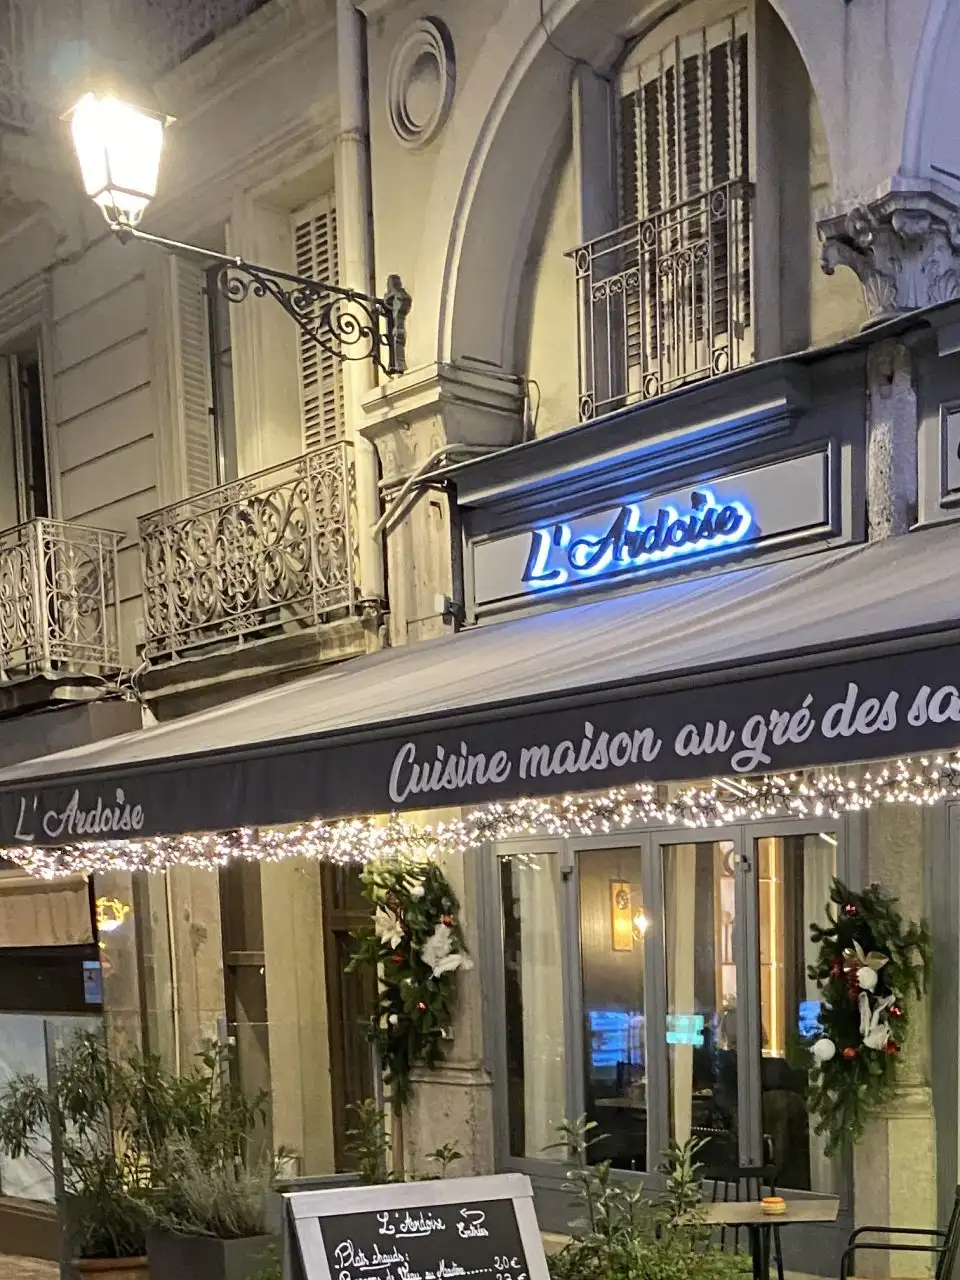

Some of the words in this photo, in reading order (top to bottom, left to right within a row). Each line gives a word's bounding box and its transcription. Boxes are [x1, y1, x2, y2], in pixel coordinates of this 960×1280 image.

[521, 490, 747, 584] L'Ardoise
[388, 741, 511, 803] Cuisine
[519, 721, 662, 779] maison
[674, 719, 736, 757] au
[731, 693, 815, 773] gré
[821, 682, 900, 738] des
[14, 788, 145, 841] L'Ardoise
[377, 1212, 446, 1234] L'Ardoise
[335, 1239, 369, 1268] Plats
